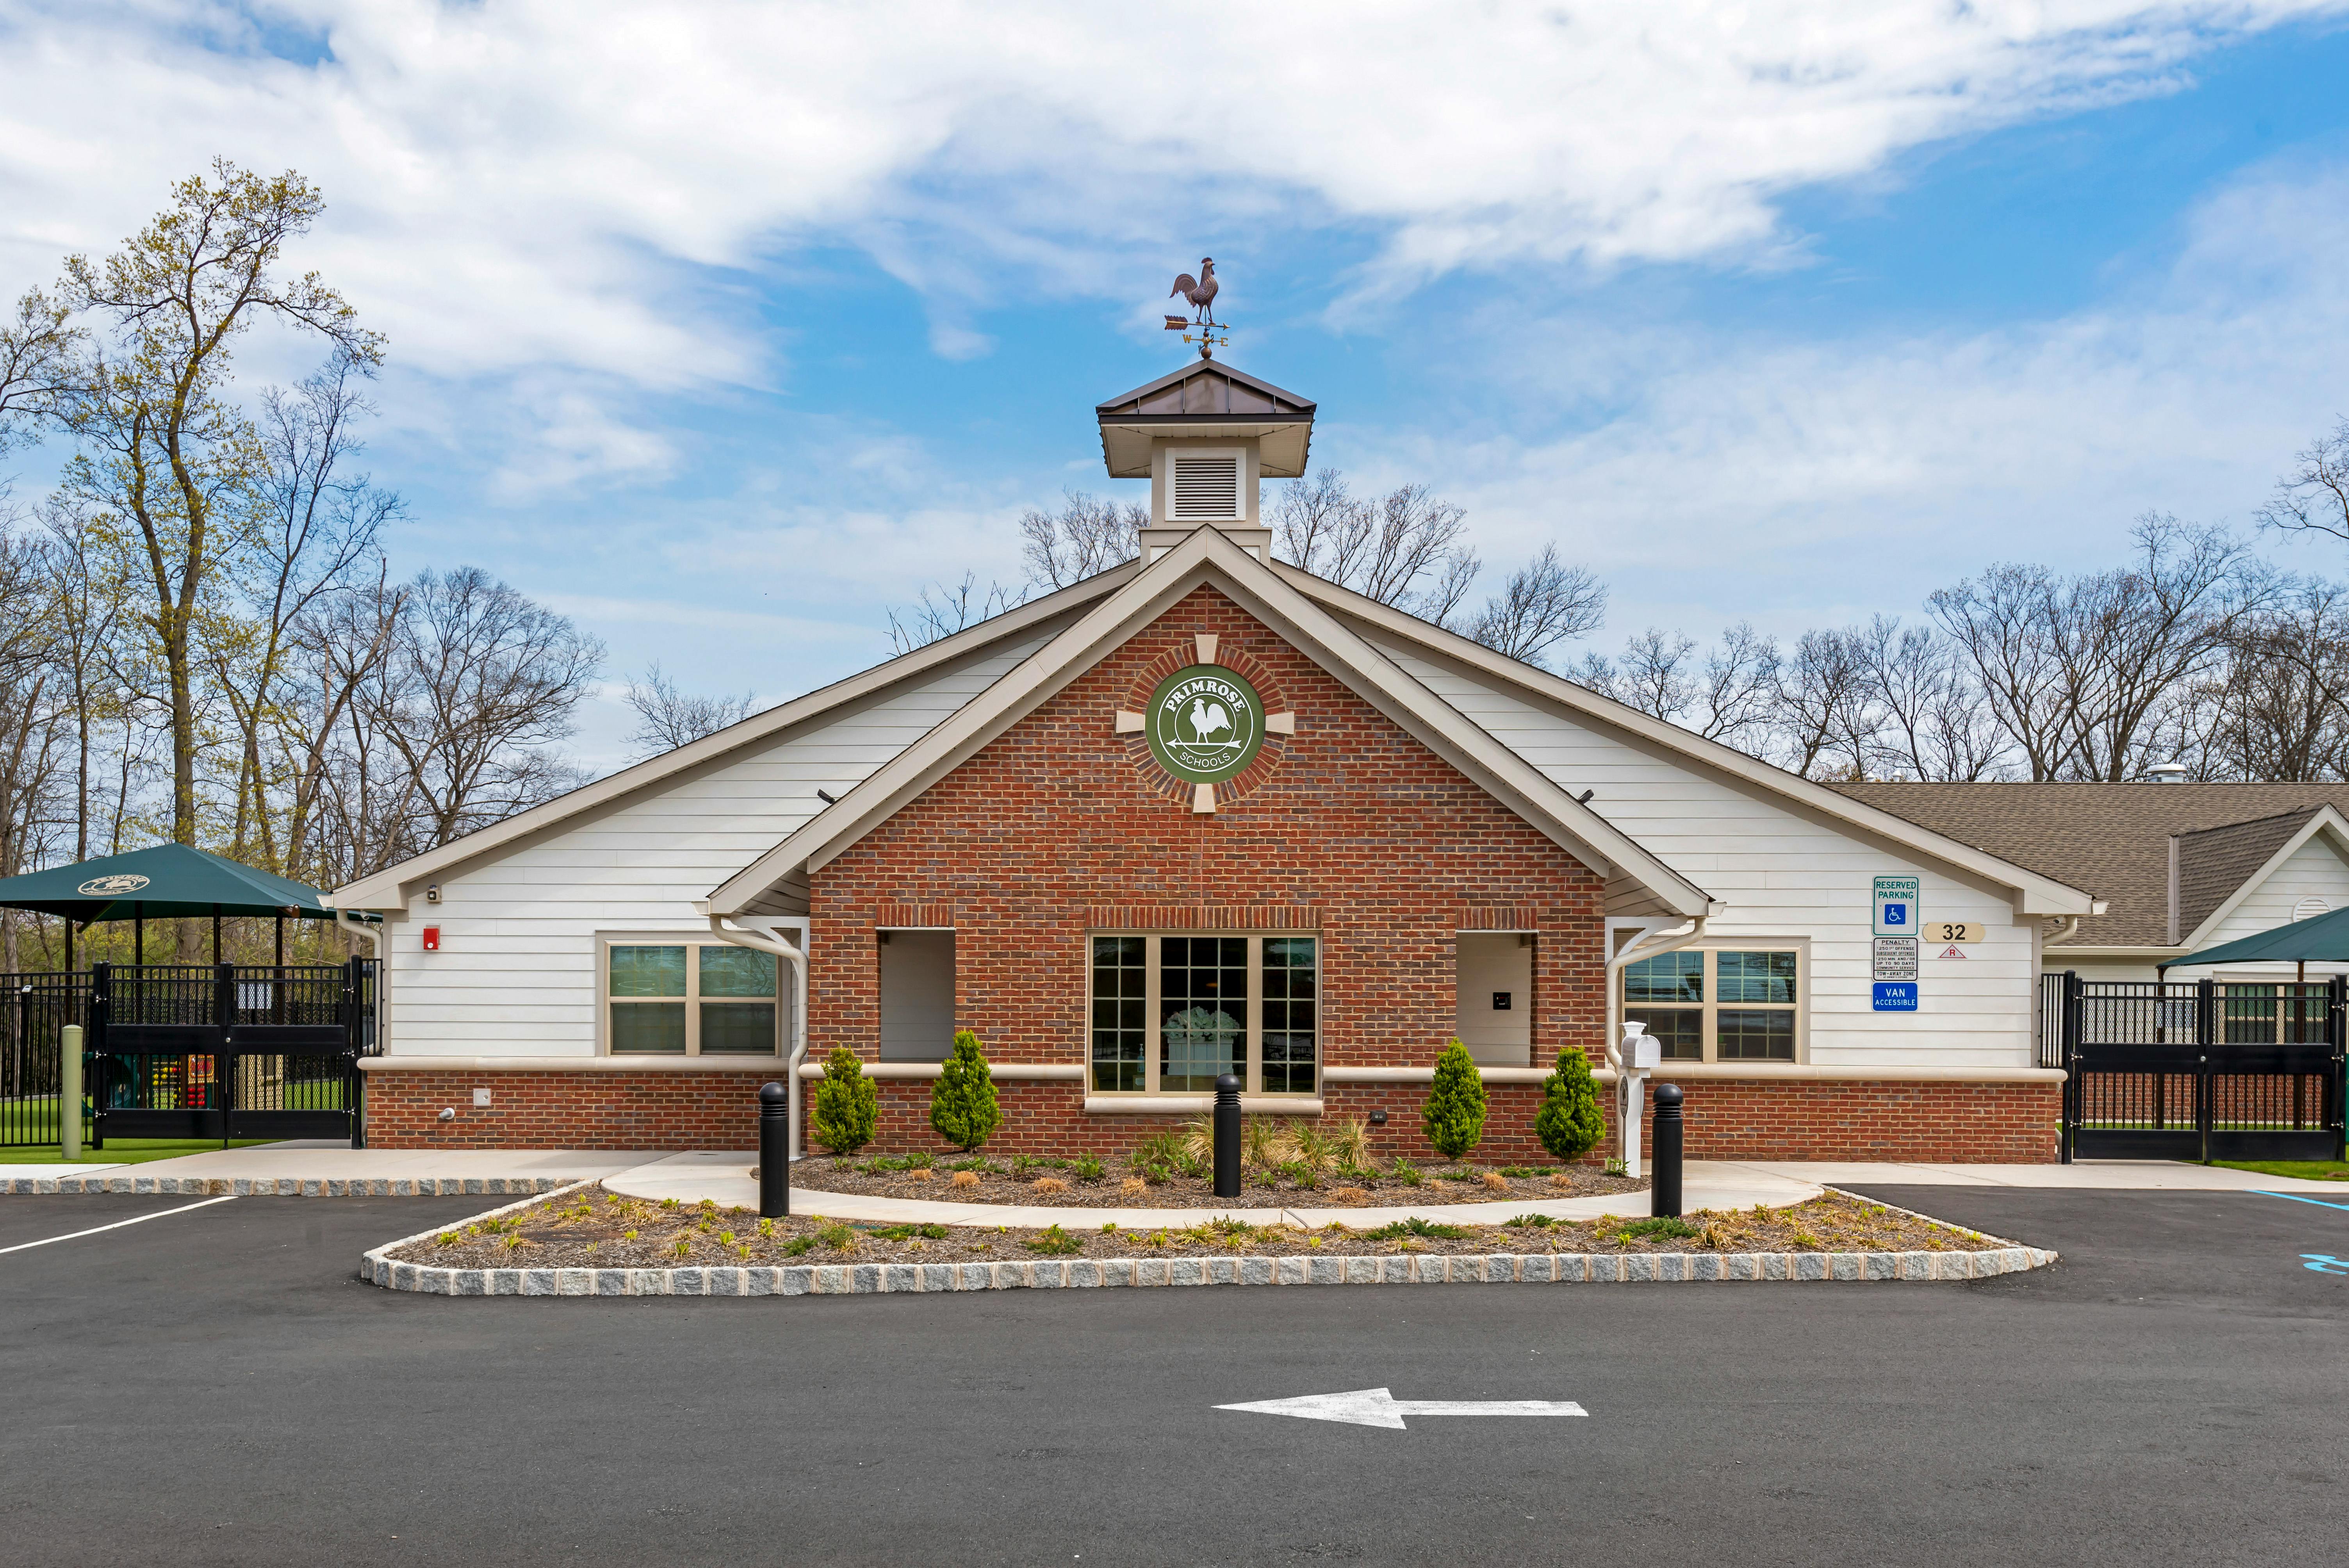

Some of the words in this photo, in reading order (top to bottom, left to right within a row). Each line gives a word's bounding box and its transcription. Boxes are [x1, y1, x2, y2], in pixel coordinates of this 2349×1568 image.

[1221, 337, 1228, 347] E
[1165, 681, 1245, 713] PRIMROSE
[1180, 752, 1230, 768] SCHOOLS
[1943, 925, 1965, 940] 32
[1886, 989, 1905, 997] VAN
